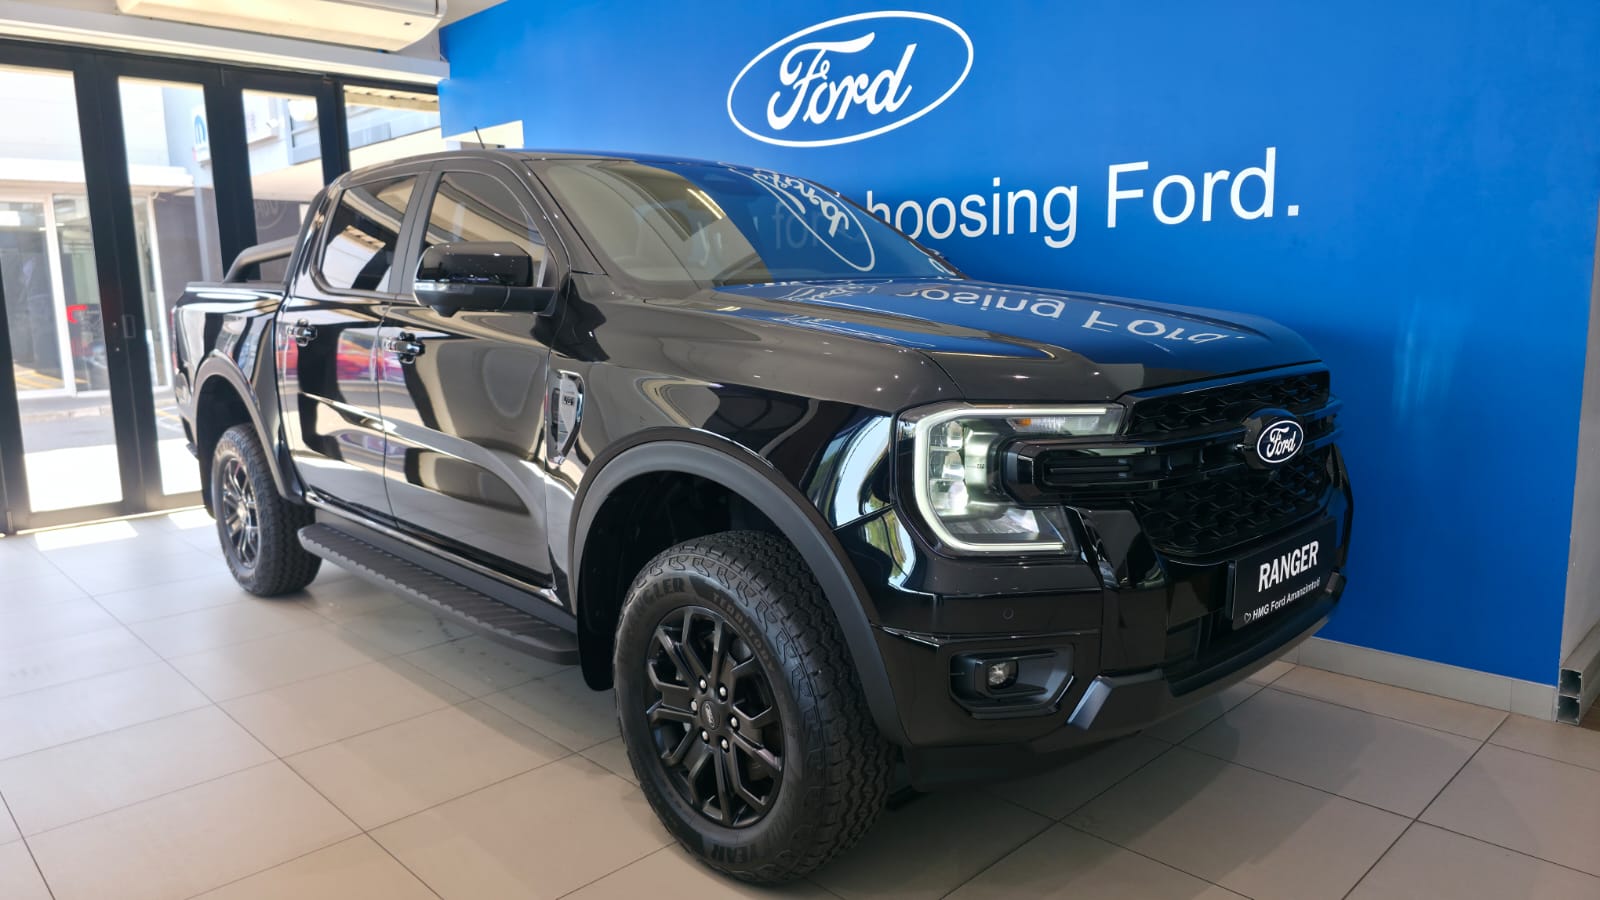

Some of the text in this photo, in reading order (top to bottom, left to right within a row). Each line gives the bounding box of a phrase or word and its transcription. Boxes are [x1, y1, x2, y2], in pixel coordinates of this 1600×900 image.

[766, 31, 918, 132] Ford
[866, 177, 1078, 249] hoosing
[1107, 146, 1300, 228] Ford.
[1266, 426, 1296, 458] Ford
[1258, 540, 1319, 593] RANGER
[1252, 604, 1270, 621] HMG
[1270, 595, 1286, 612] Ford
